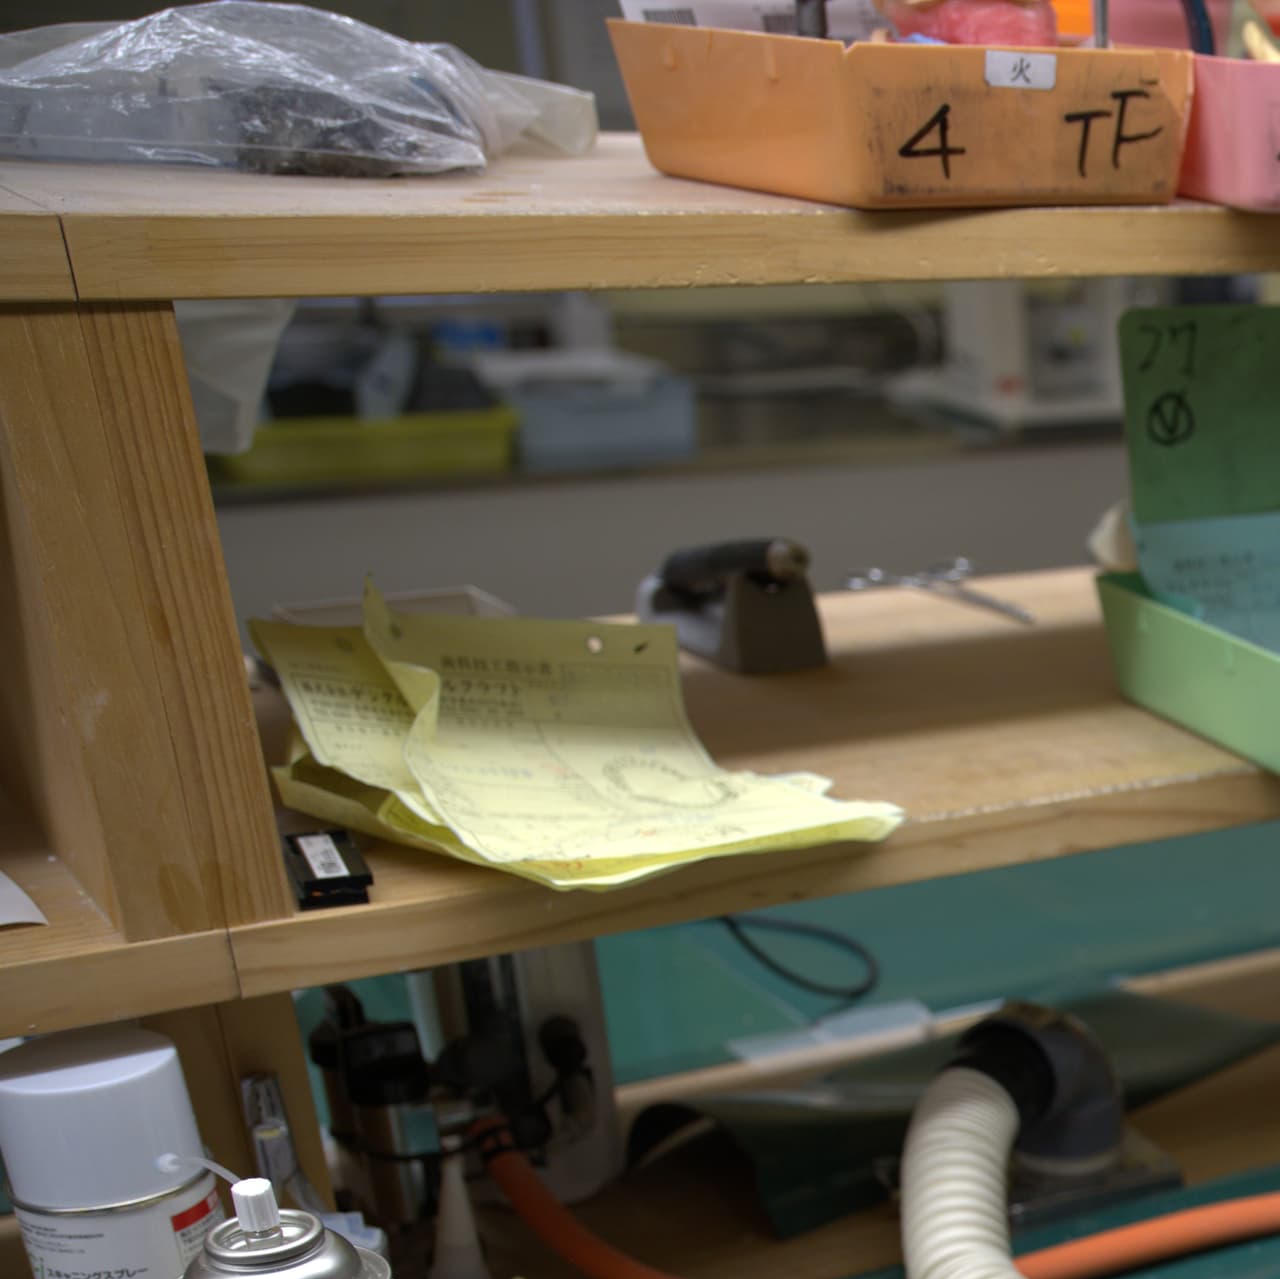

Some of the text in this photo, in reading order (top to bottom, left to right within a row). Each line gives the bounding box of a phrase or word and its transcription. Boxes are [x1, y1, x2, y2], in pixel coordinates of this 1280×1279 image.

[1010, 56, 1032, 83] 火
[899, 88, 1163, 179] 4 TF
